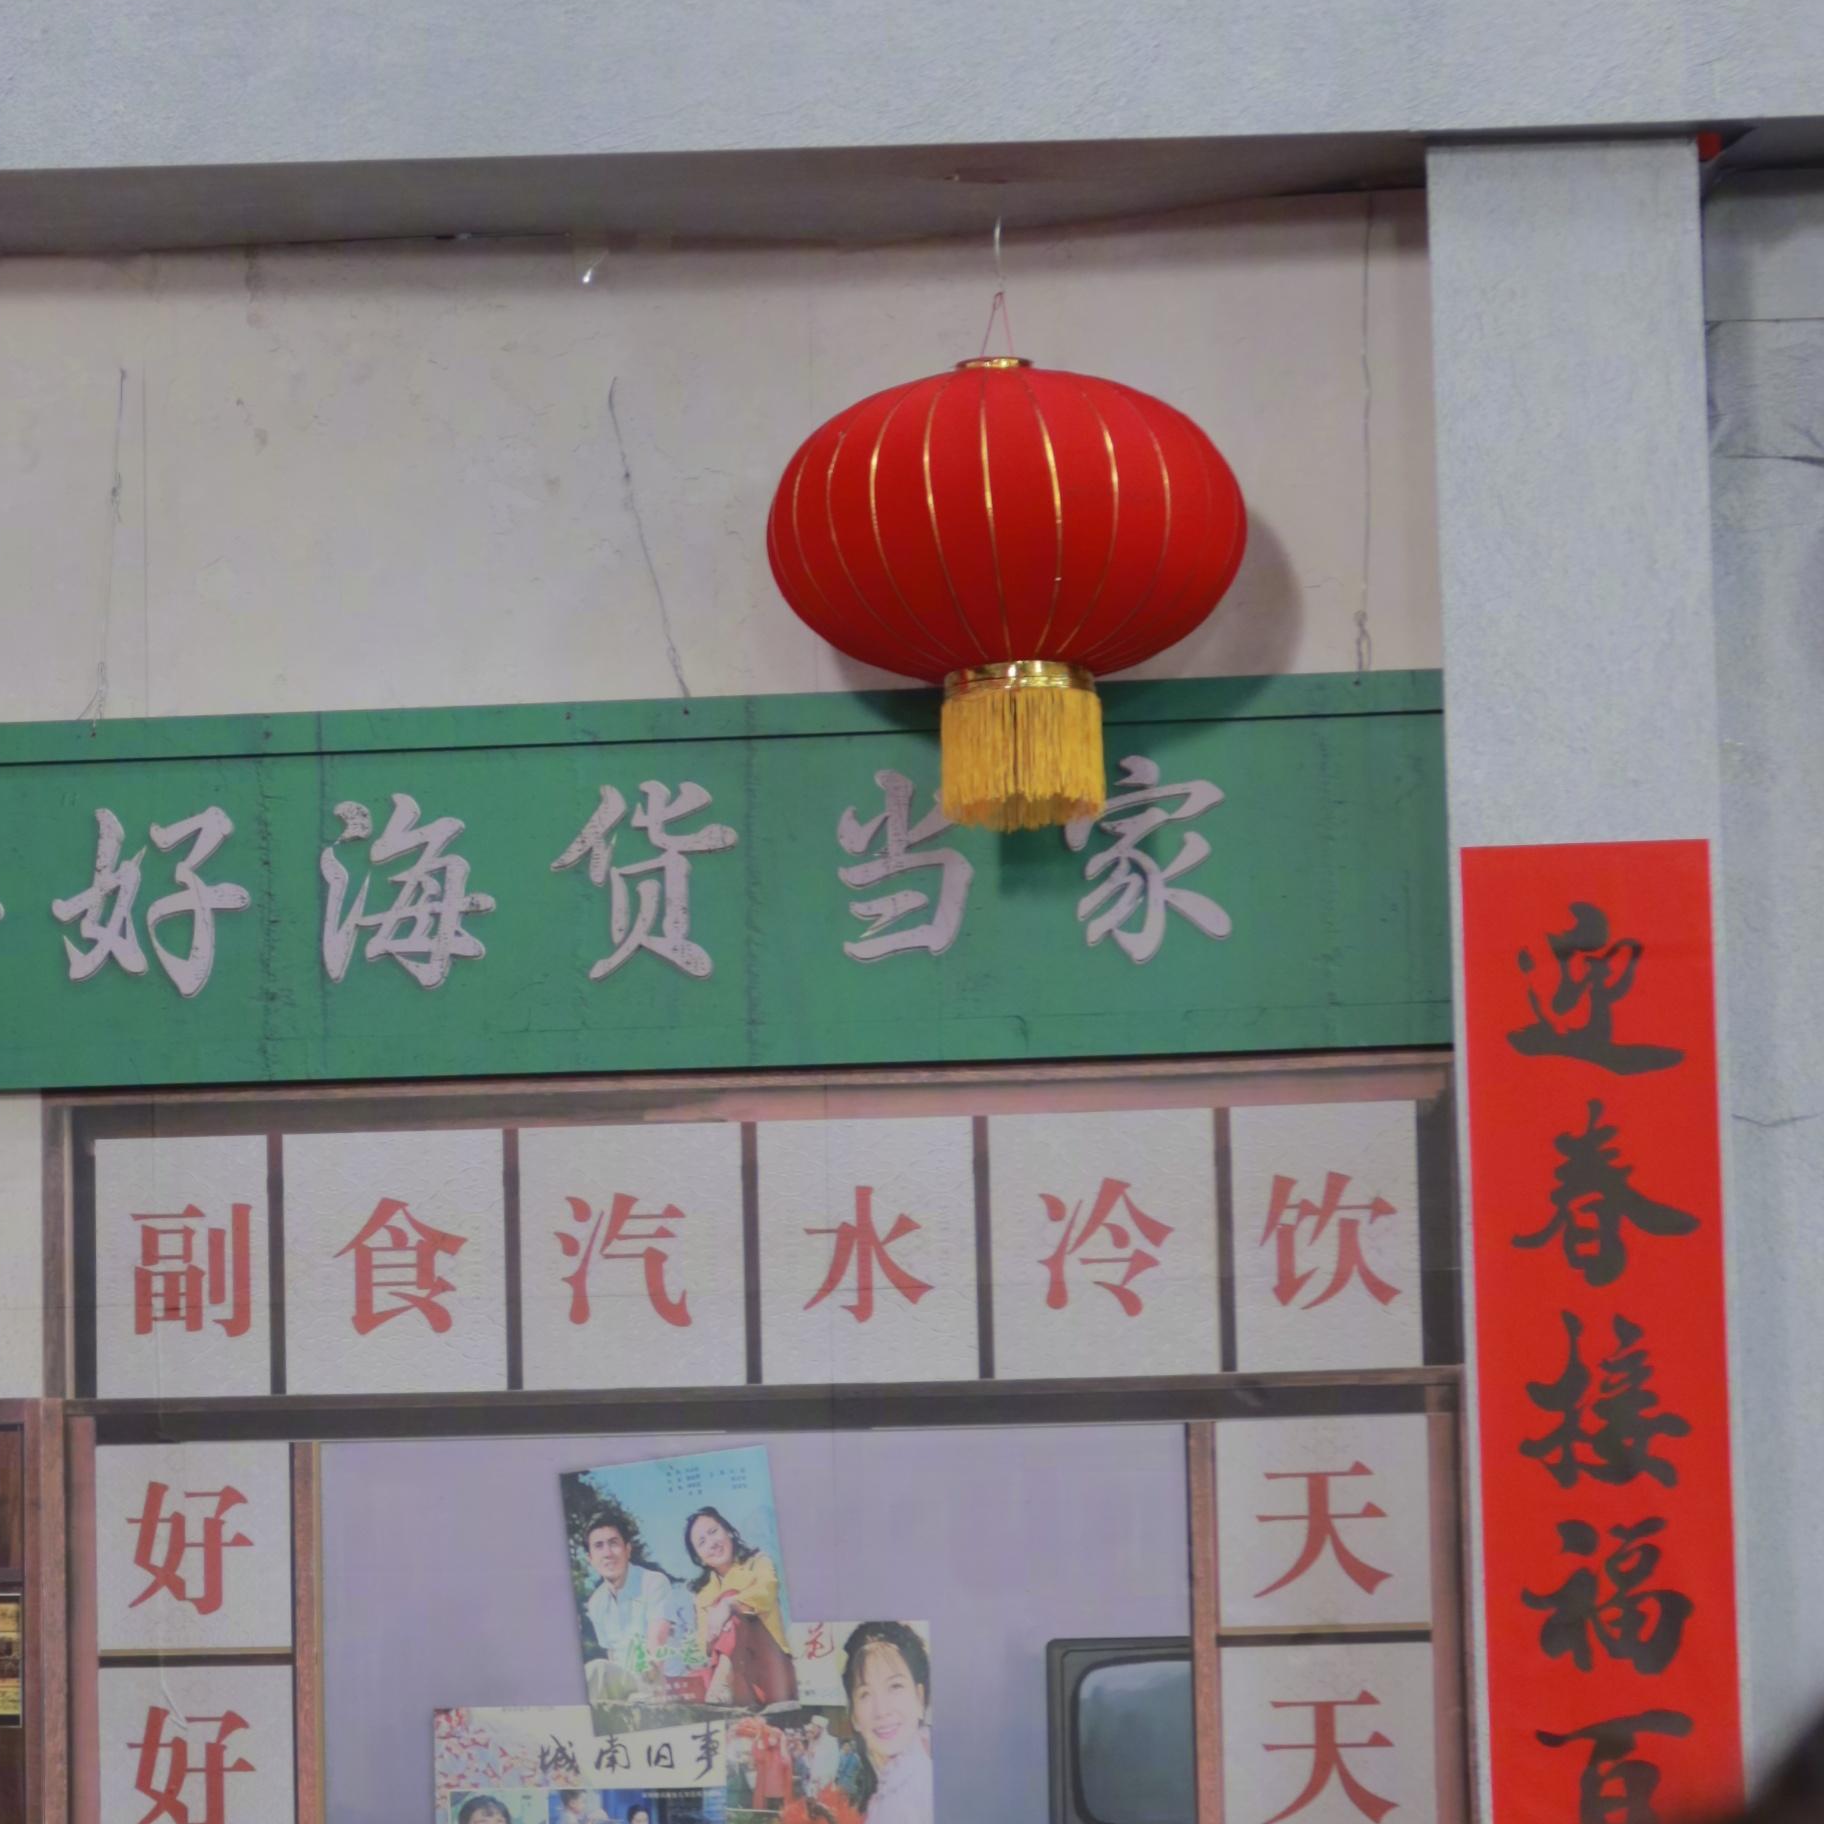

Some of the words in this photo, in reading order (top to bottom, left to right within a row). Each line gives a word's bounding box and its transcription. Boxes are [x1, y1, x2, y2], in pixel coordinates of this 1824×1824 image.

[130, 1170, 1404, 1340] 副食汽水冷饮
[538, 1720, 721, 1781] 城南旧事
